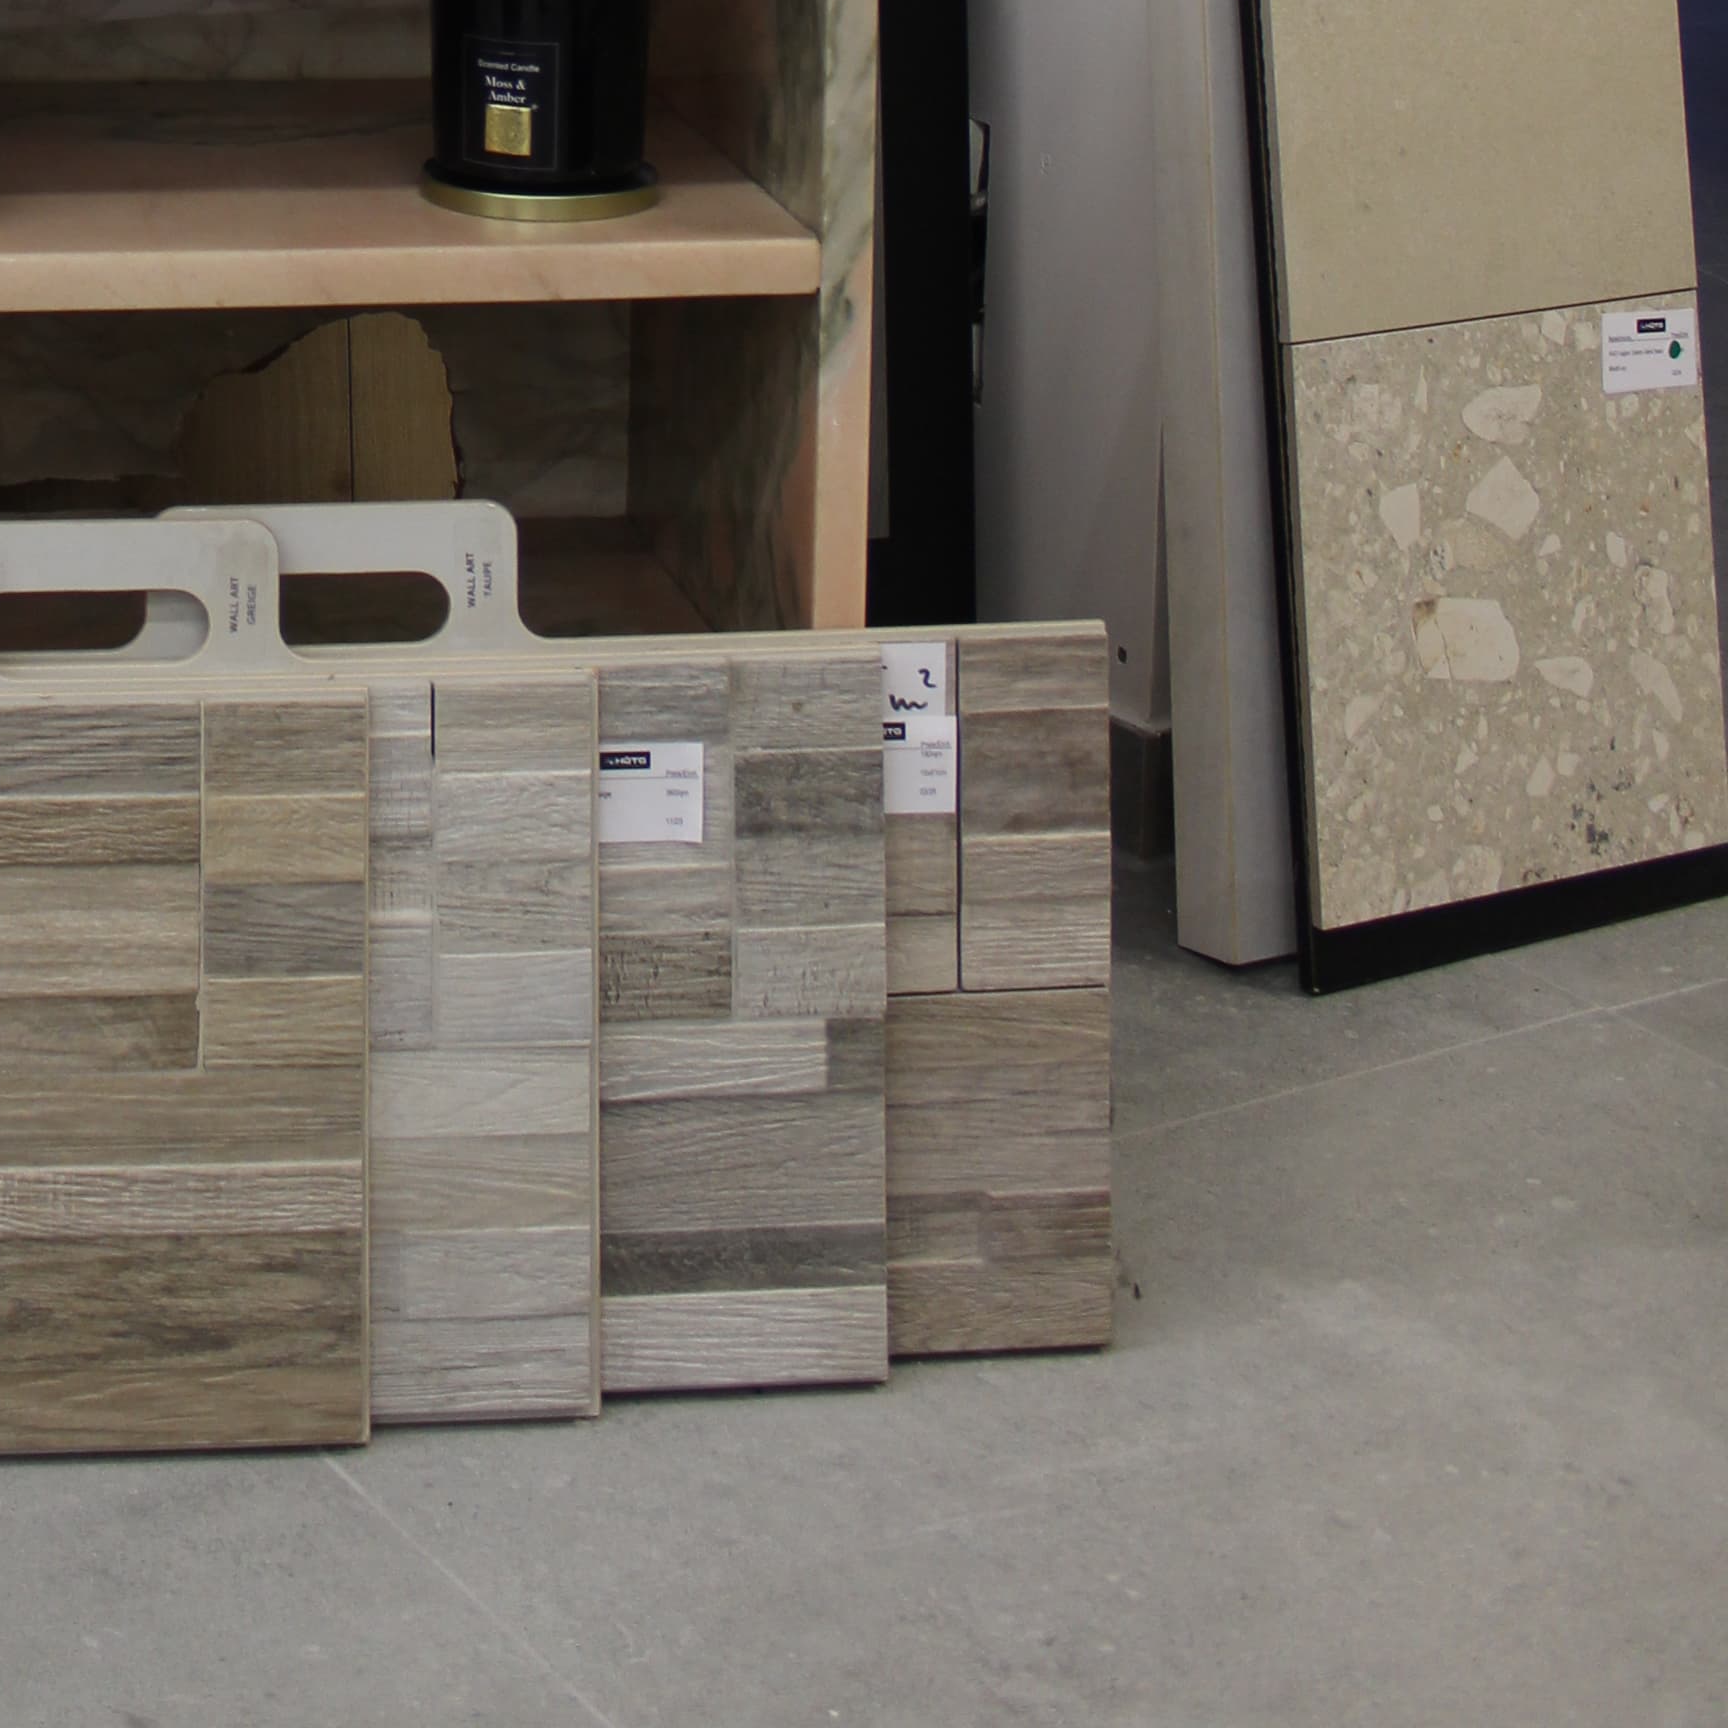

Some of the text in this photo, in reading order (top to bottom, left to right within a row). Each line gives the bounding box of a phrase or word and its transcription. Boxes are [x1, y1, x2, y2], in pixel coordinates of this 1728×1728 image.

[485, 75, 526, 91] Moss &
[488, 89, 528, 104] Amber
[465, 552, 476, 608] WALL ART
[482, 561, 493, 597] TAUPE
[229, 577, 240, 633] WALL ART
[246, 584, 257, 625] GREIGE
